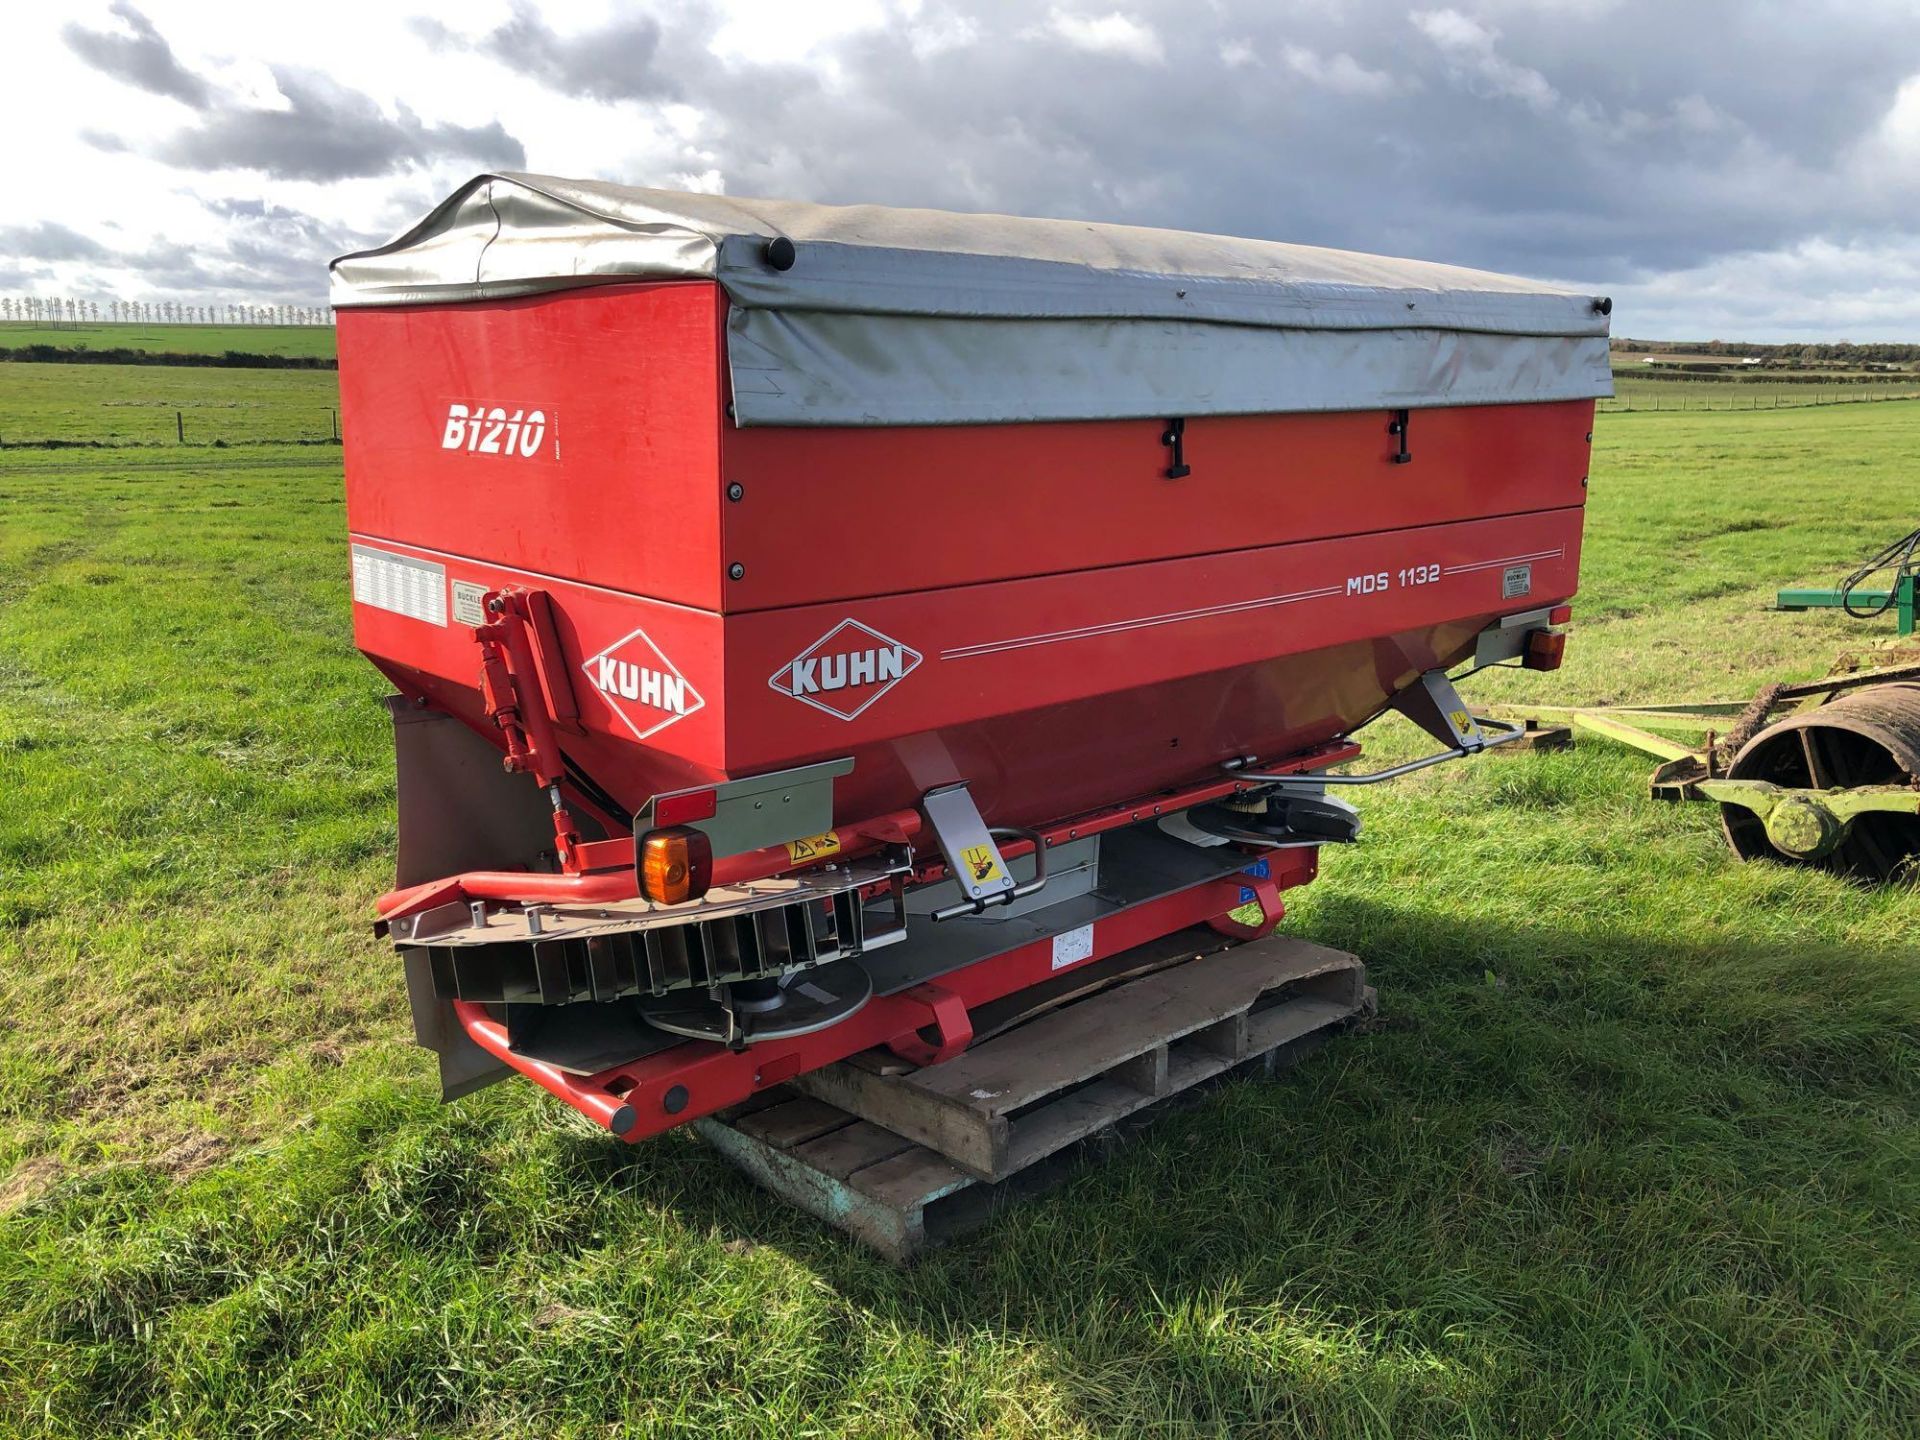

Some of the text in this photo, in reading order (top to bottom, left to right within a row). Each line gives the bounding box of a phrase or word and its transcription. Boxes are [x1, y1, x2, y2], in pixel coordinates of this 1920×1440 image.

[442, 404, 545, 457] B1210
[457, 591, 481, 605] BUCKLE
[1346, 564, 1440, 596] MDS 1132
[599, 655, 685, 715] KUHN
[792, 645, 902, 696] KUHN
